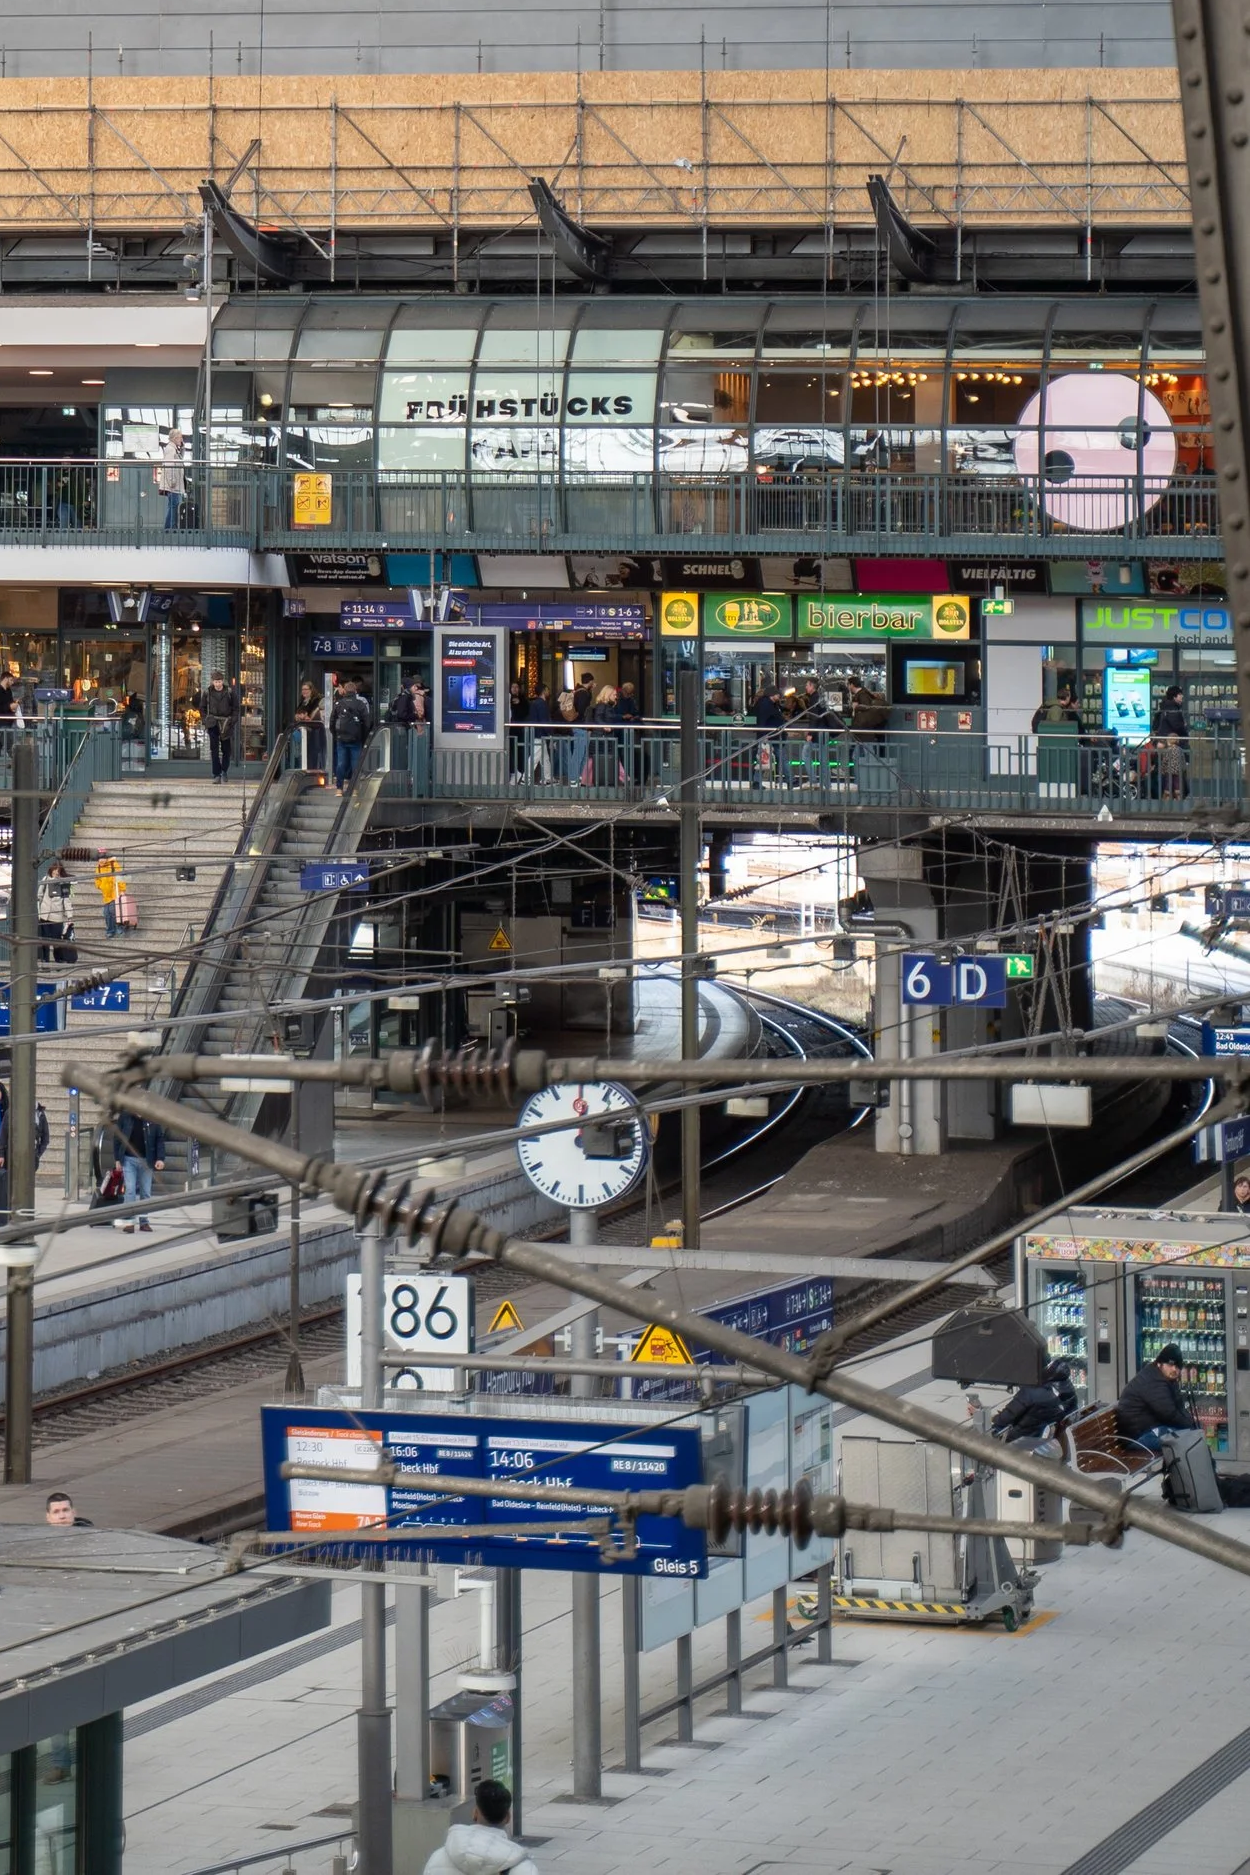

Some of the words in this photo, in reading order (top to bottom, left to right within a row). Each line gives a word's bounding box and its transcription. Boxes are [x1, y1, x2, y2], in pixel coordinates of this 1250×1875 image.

[405, 392, 634, 420] FRÜHSTÜCKS
[682, 563, 735, 576] SCHNEL
[961, 566, 1037, 580] VIELFÄLTIG
[352, 605, 375, 614] 11-14
[618, 607, 632, 617] 1-6
[807, 600, 923, 630] bierbar
[1085, 607, 1234, 631] JUSTCO
[313, 639, 332, 653] 7-8
[1174, 633, 1201, 645] tech
[1205, 634, 1228, 645] and
[907, 961, 931, 999] 6
[960, 963, 987, 1001] D
[98, 986, 111, 1006] 7
[1215, 1042, 1229, 1051] Bad
[296, 1441, 323, 1453] 12:30
[390, 1445, 418, 1458] 16:06
[490, 1451, 534, 1469] 14:06
[638, 1461, 666, 1473] 11420
[422, 1464, 440, 1475] Hbf
[654, 1558, 687, 1574] Gleis
[688, 1559, 699, 1575] 5
